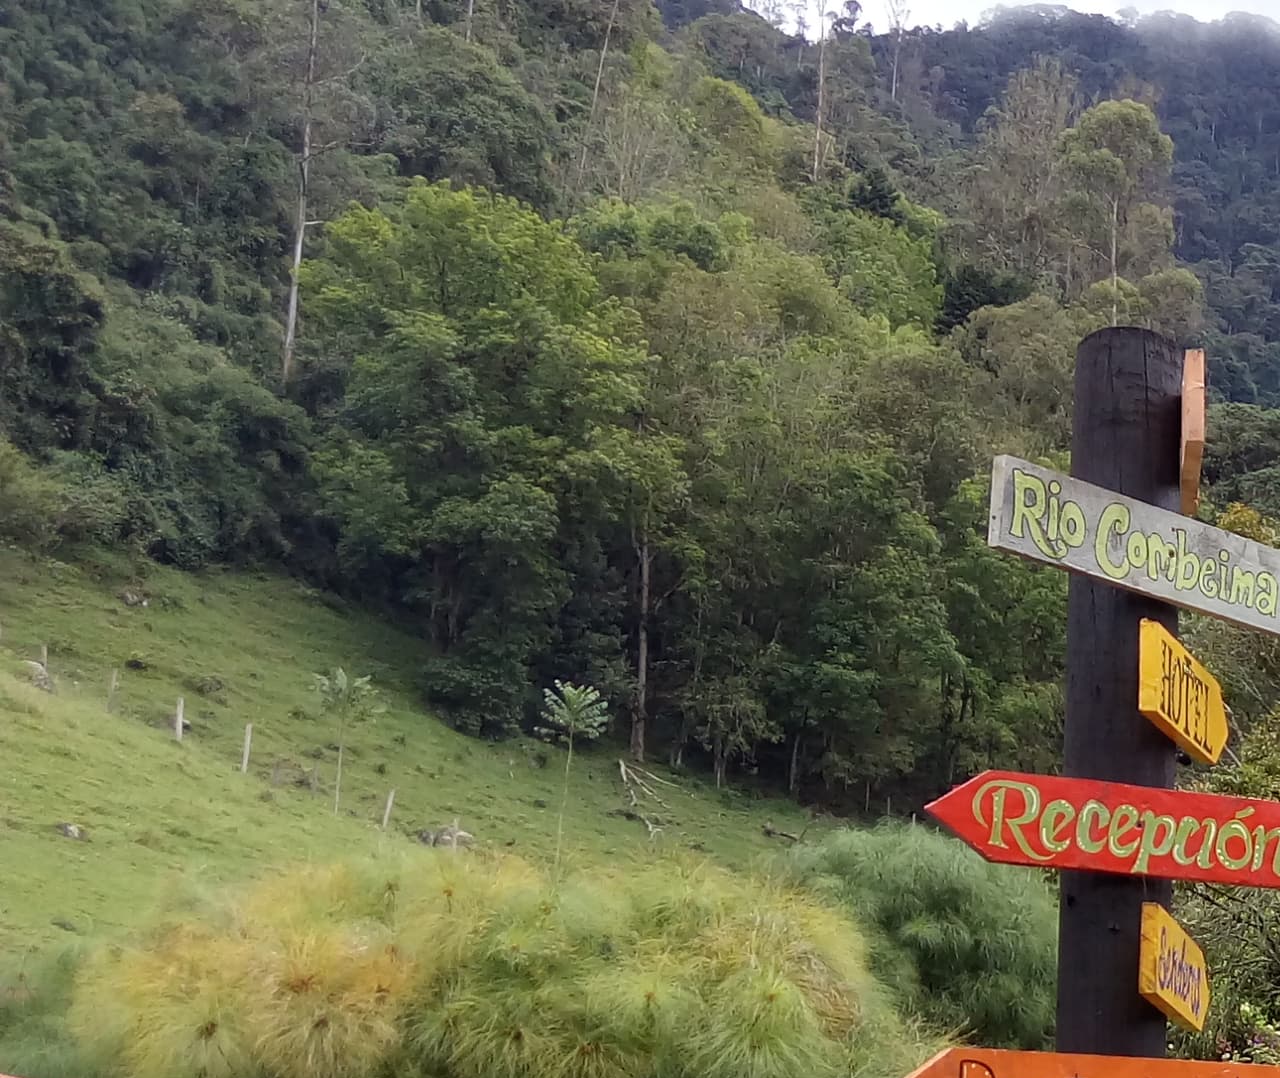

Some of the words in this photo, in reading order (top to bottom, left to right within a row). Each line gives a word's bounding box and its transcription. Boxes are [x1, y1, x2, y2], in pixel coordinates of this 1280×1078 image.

[1009, 468, 1086, 559] Rio
[1094, 502, 1279, 618] Combeima
[1160, 639, 1213, 755] HOTEL
